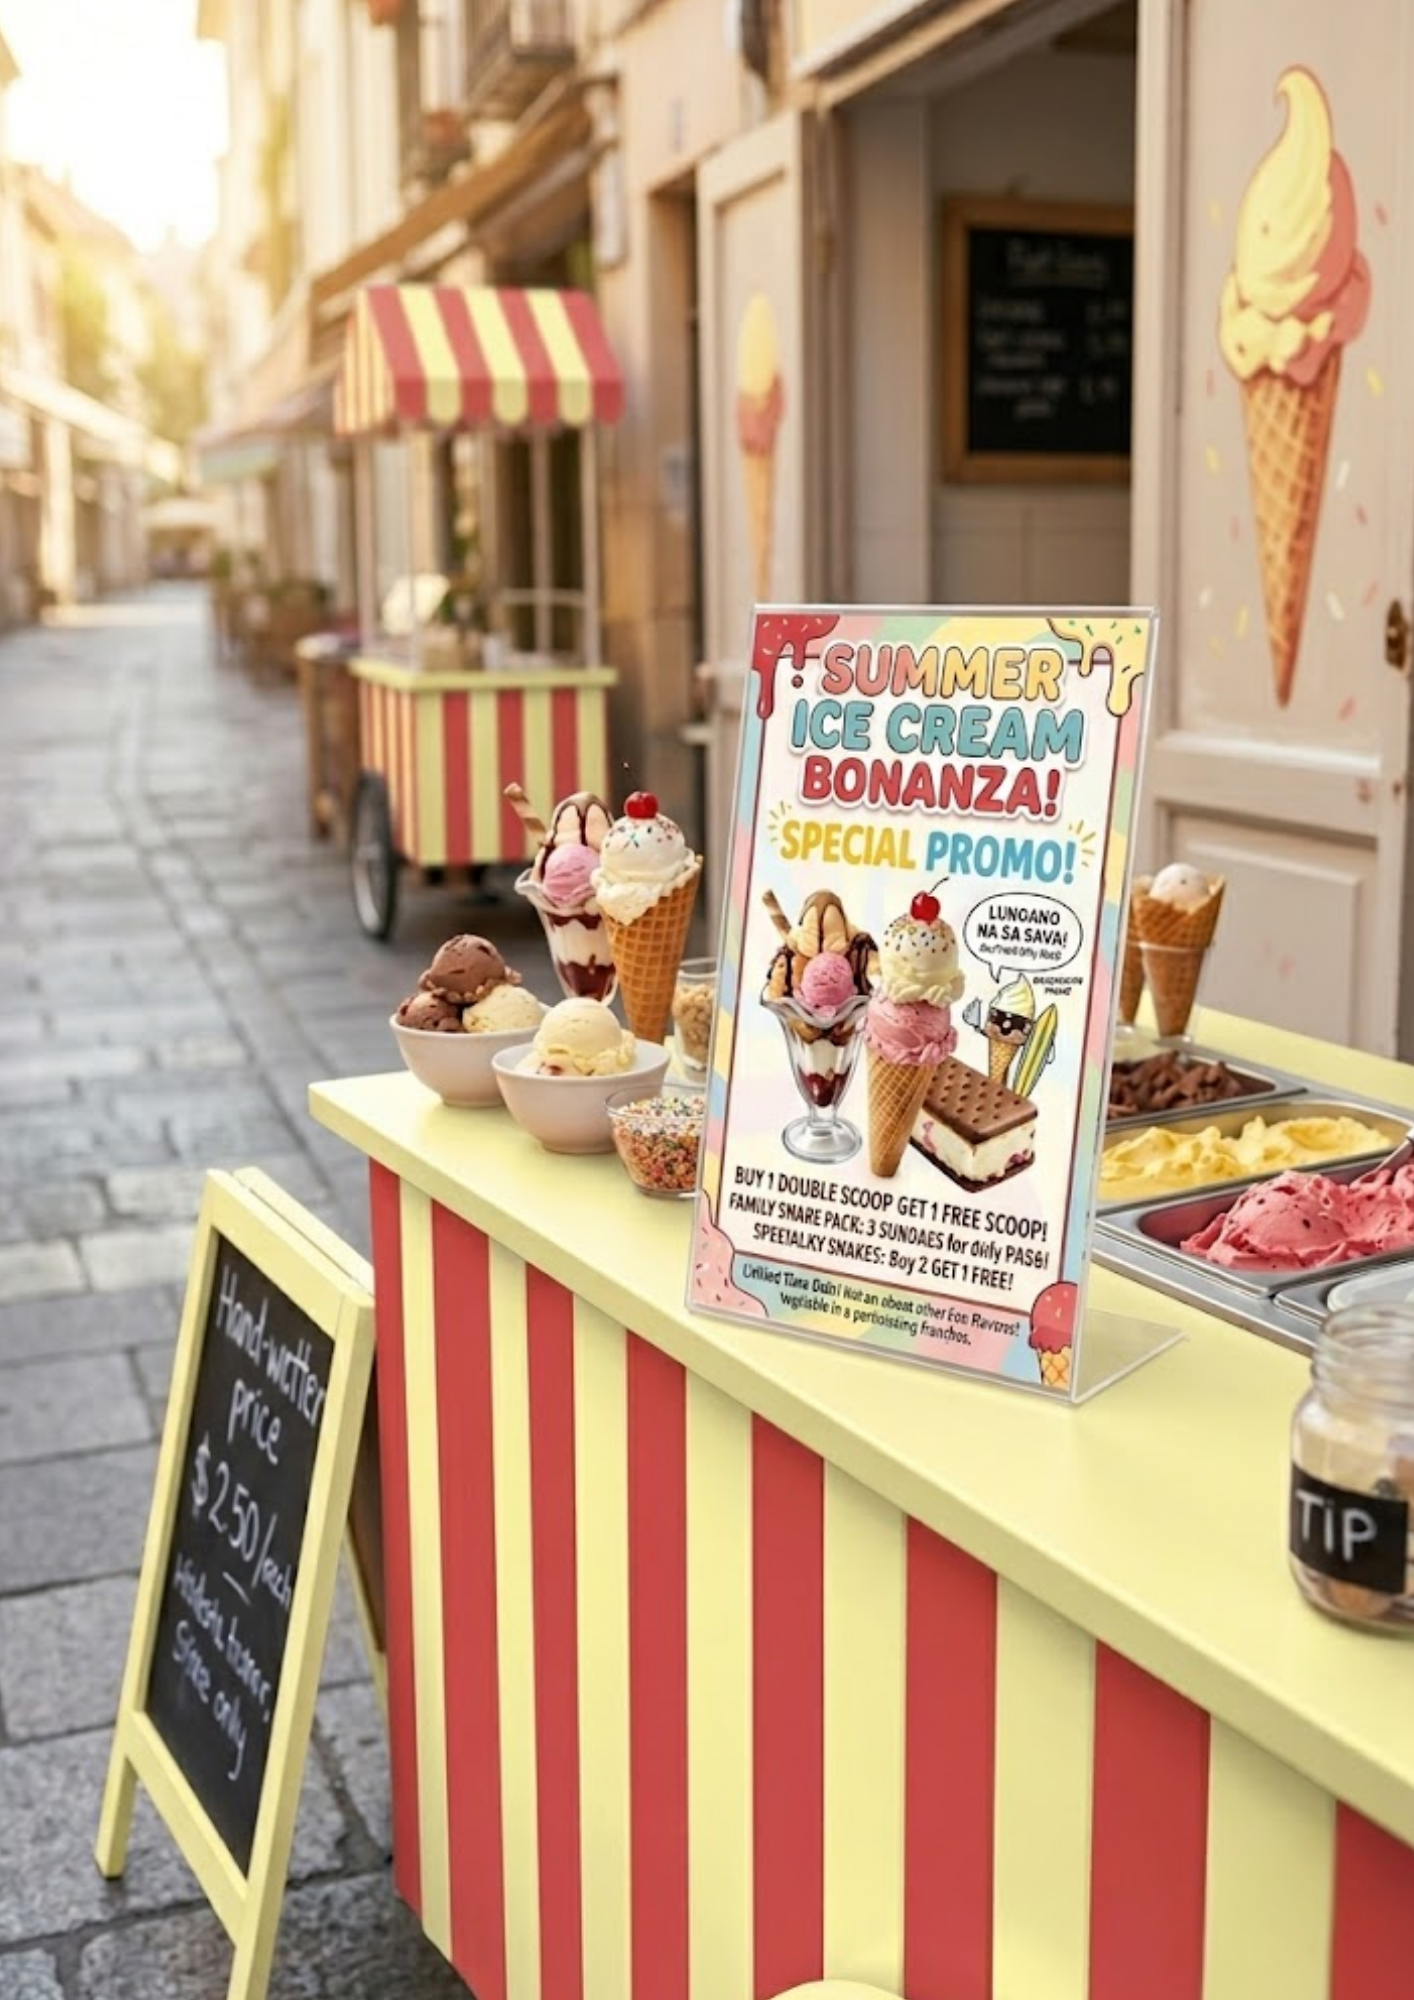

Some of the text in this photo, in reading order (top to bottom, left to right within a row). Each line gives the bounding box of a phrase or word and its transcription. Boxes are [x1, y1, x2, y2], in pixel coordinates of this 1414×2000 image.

[821, 644, 1064, 701] SUMMER
[791, 699, 1084, 764] ICE CREAM
[802, 755, 1060, 817] BONANZA!
[780, 819, 1077, 885] SPECIAL PROMO!
[977, 924, 1068, 949] NA SA SAVA!
[728, 1192, 776, 1217] FAMILY
[823, 1210, 864, 1235] PACK:
[866, 1218, 877, 1236] 3
[735, 1166, 1048, 1242] BUY 1 DOUBLE SCOOP GET 1 FREE SCOOP!
[918, 1256, 928, 1274] 2
[932, 1258, 959, 1280] GET
[962, 1264, 968, 1281] 1
[971, 1266, 1014, 1290] FREE!
[831, 1301, 842, 1315] in
[844, 1307, 850, 1318] a
[916, 1303, 946, 1319] other
